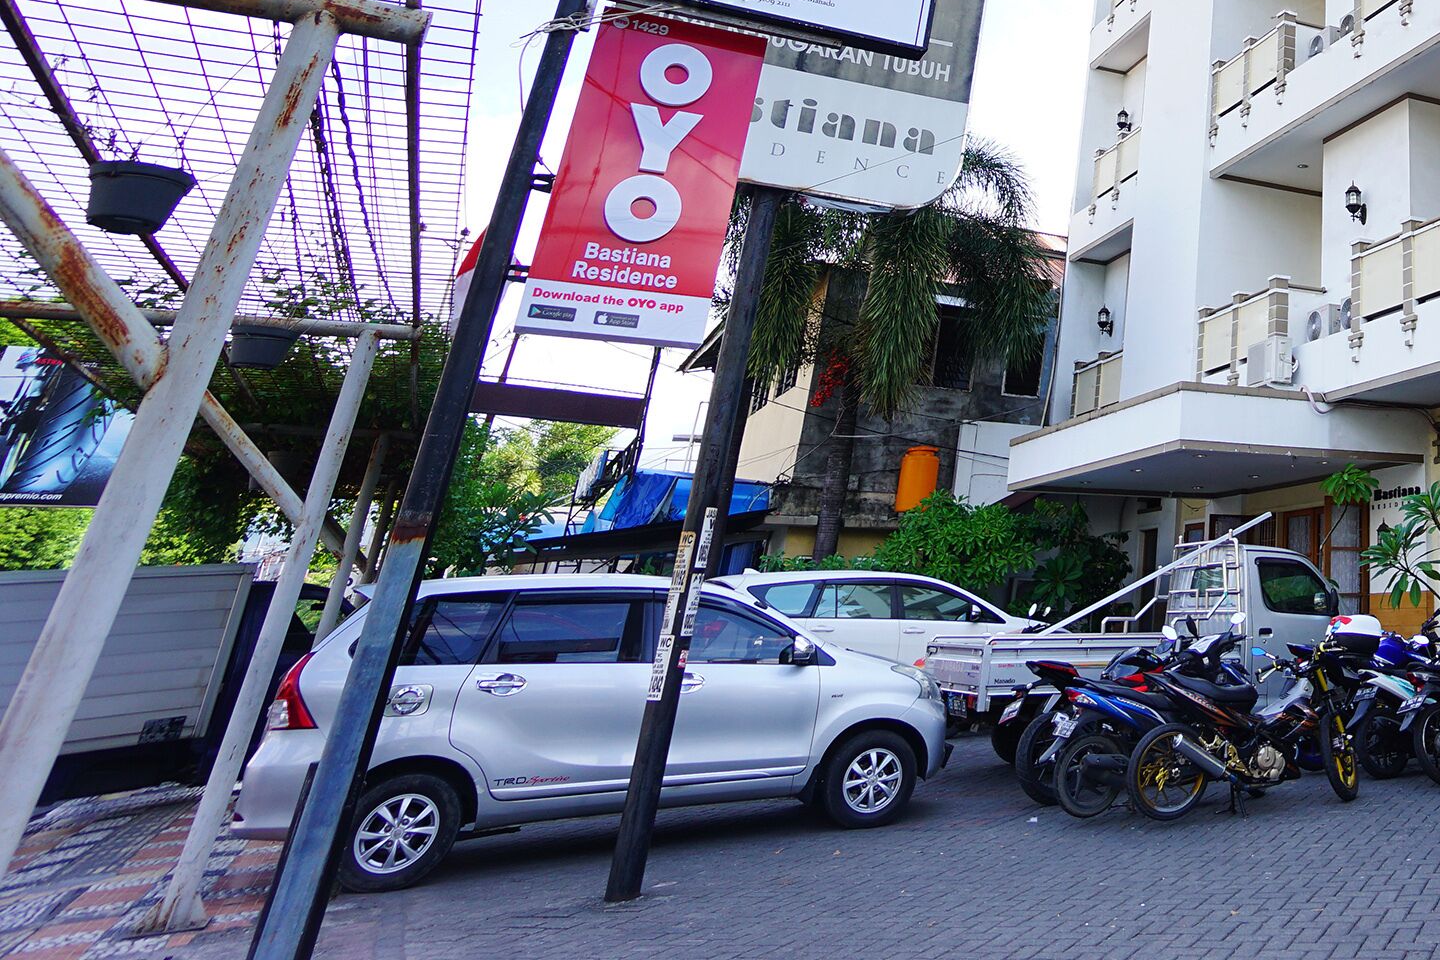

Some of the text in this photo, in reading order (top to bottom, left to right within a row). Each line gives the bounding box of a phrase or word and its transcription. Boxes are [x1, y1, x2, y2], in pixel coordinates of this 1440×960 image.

[632, 19, 669, 36] 1429
[603, 42, 713, 243] OYO
[583, 241, 672, 269] Bastiana
[571, 260, 678, 289] Residence
[532, 287, 684, 315] Download the OYO app
[0, 492, 63, 502] apremio.com
[993, 677, 1016, 685] Manado
[493, 776, 527, 785] TRD
